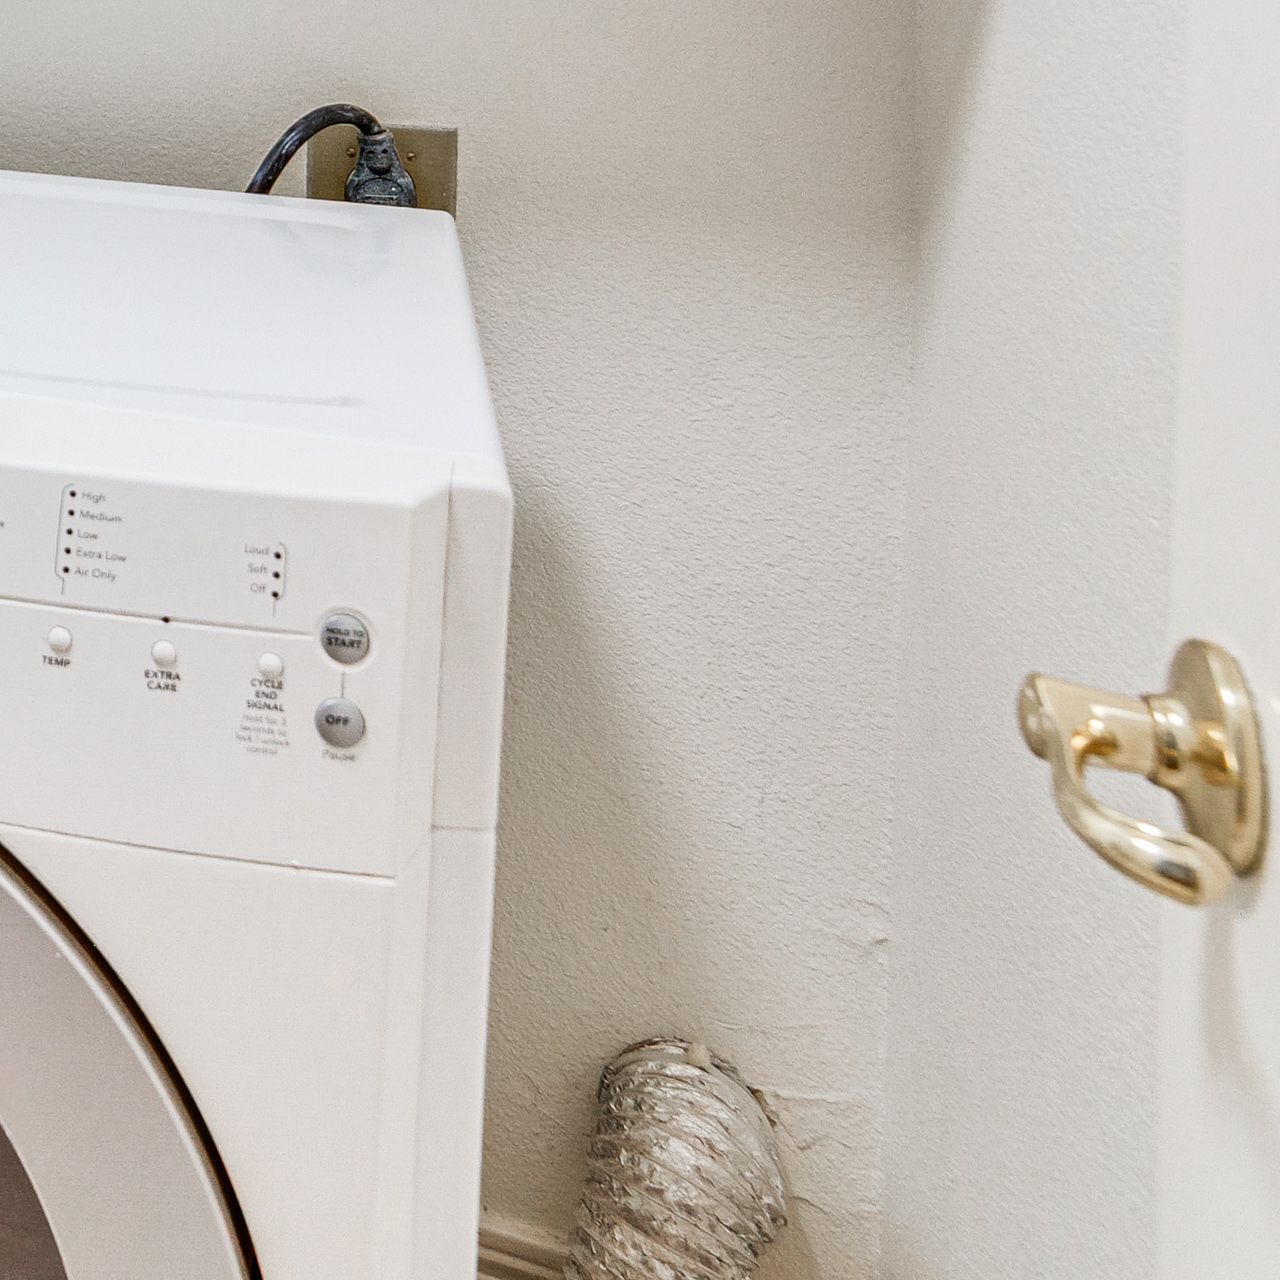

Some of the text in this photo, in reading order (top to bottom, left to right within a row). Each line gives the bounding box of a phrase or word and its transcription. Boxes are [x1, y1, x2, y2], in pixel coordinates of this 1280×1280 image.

[82, 491, 106, 504] High
[79, 510, 123, 523] Medium
[77, 528, 98, 540] Low
[75, 547, 127, 563] Extra Low
[244, 543, 270, 555] Loud
[74, 564, 117, 582] Air Only
[247, 563, 268, 574] Soft
[326, 636, 362, 649] START
[42, 655, 71, 668] TEMP
[144, 669, 182, 682] EXTRA
[147, 680, 177, 692] CARE
[250, 678, 284, 690] CYCLE
[255, 690, 278, 700] END
[246, 700, 285, 712] SIGNAL
[325, 714, 349, 726] OFF
[322, 749, 356, 762] Pause
